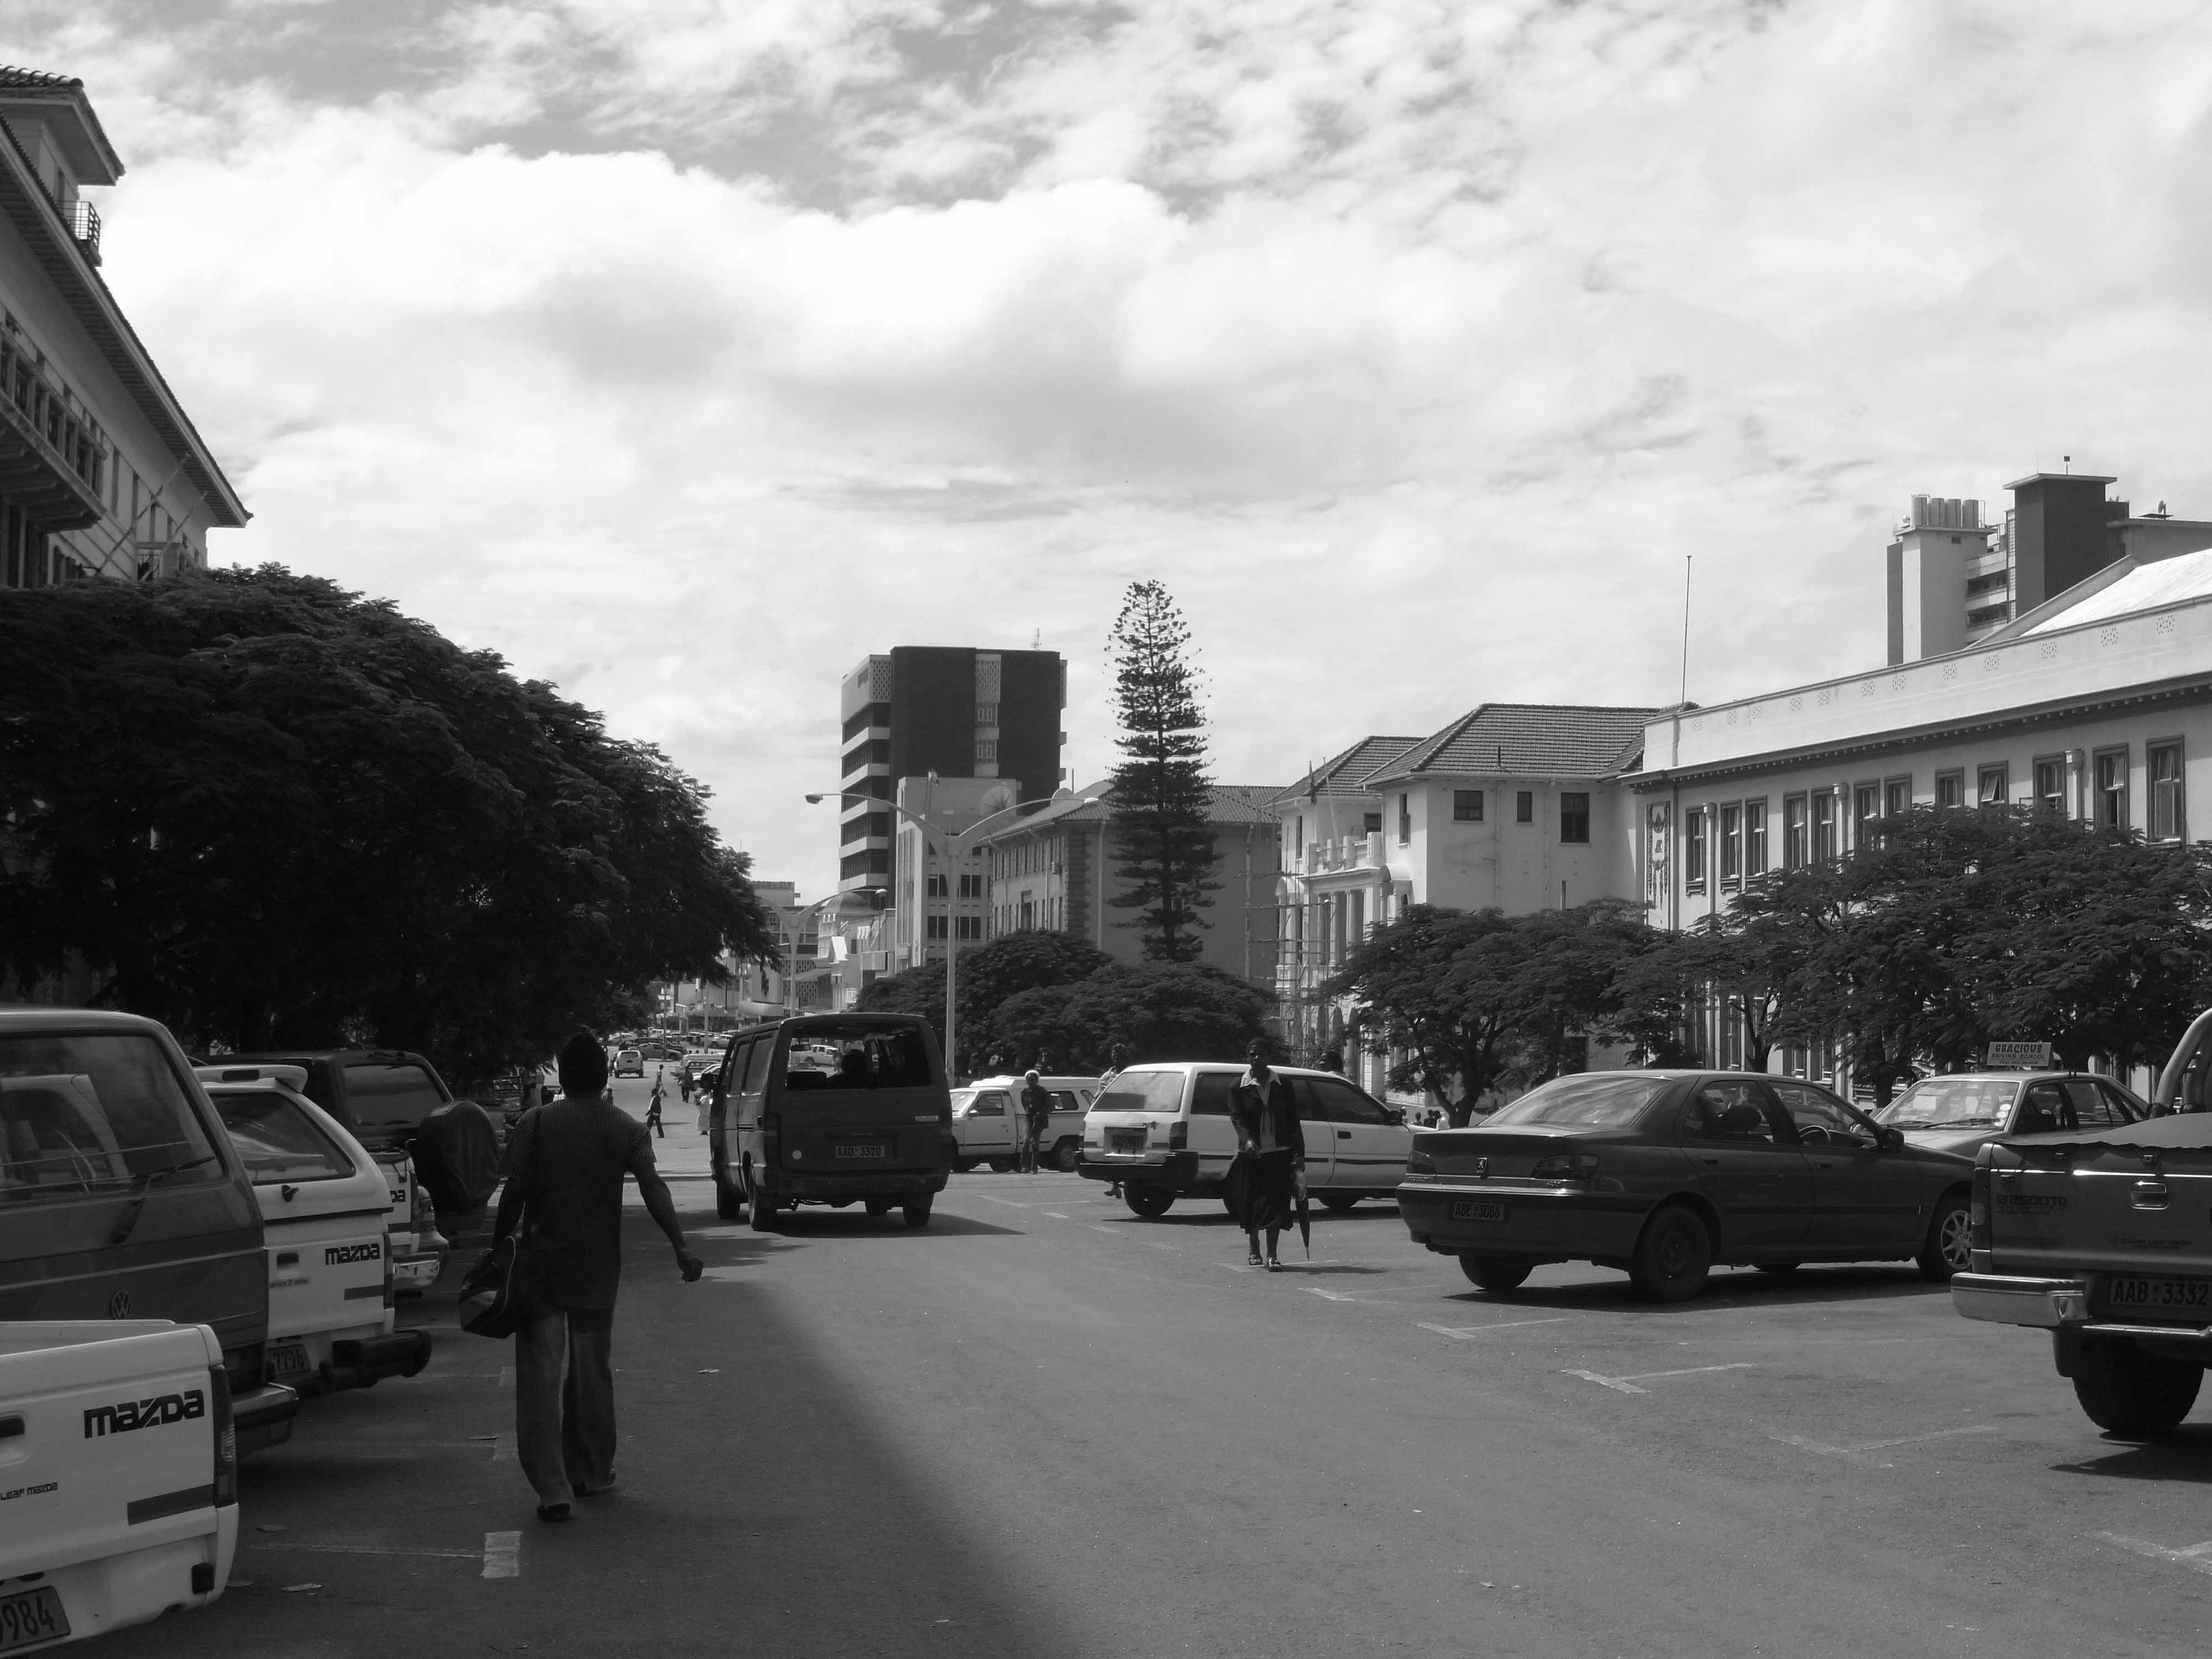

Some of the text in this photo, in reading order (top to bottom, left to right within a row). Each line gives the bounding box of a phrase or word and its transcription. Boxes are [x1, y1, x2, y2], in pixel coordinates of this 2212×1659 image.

[1995, 1044, 2043, 1053] GRACIOUS
[1455, 1203, 1500, 1218] ABE 3086
[325, 1243, 380, 1266] mazda
[2114, 1280, 2208, 1306] AAB 3332
[84, 1389, 205, 1439] mazda
[0, 1595, 55, 1644] 984
